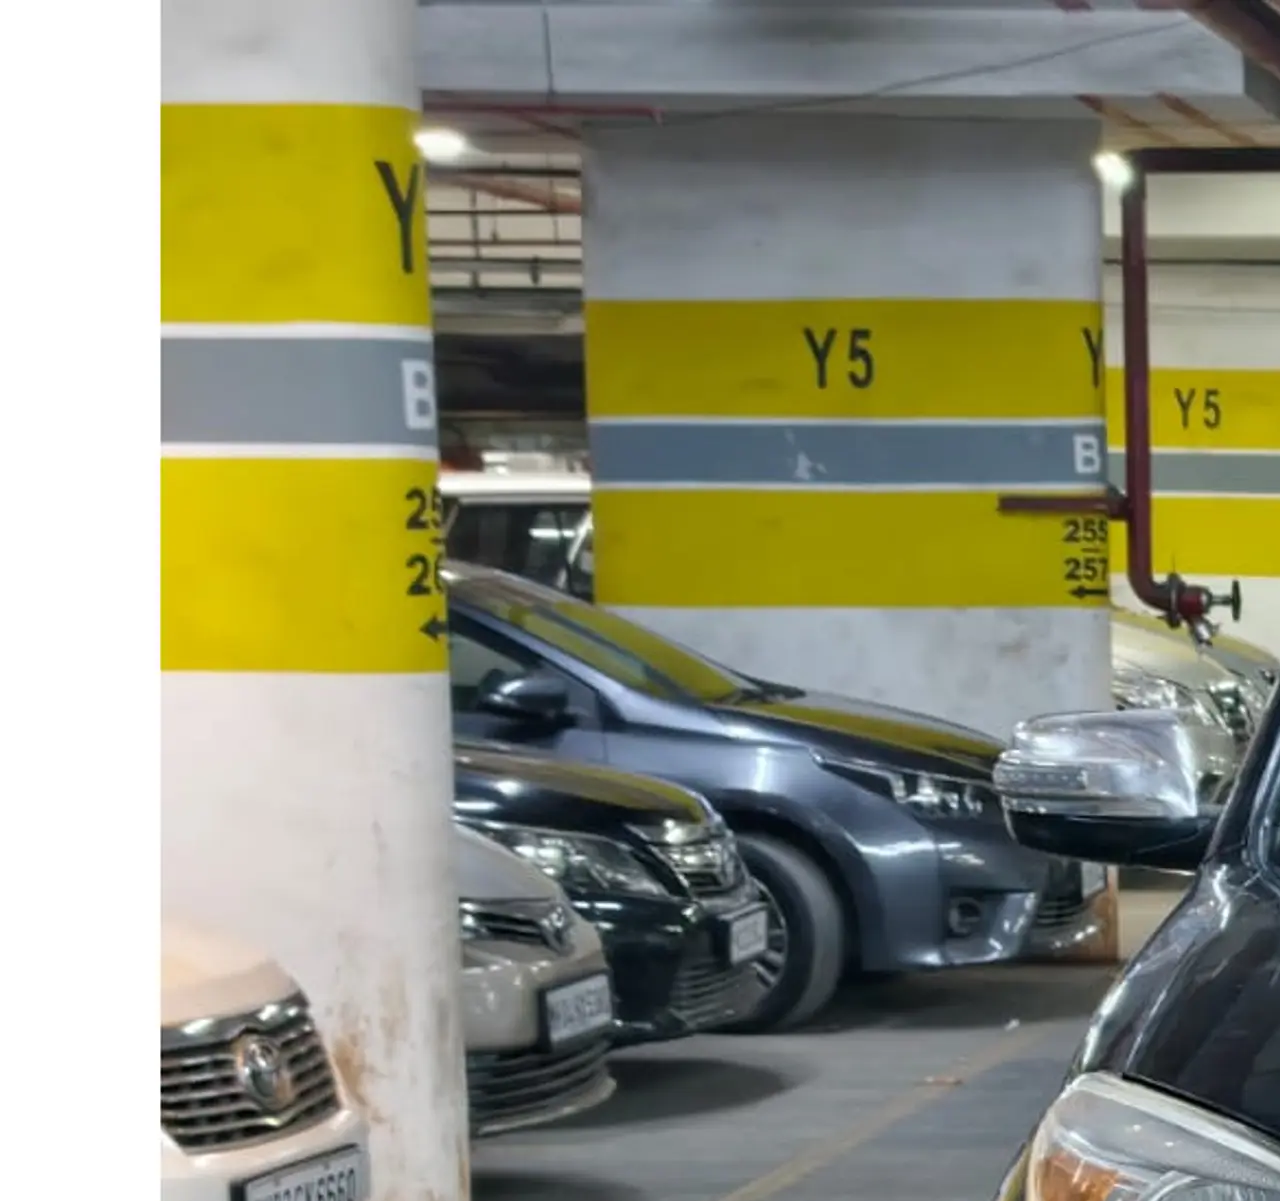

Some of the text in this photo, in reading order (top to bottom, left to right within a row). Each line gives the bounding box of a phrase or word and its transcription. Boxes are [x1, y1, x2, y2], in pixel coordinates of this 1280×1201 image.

[803, 327, 875, 389] Y5
[402, 358, 437, 430] B
[1174, 387, 1222, 429] Y5
[1073, 433, 1101, 474] B
[1064, 557, 1108, 582] 257
